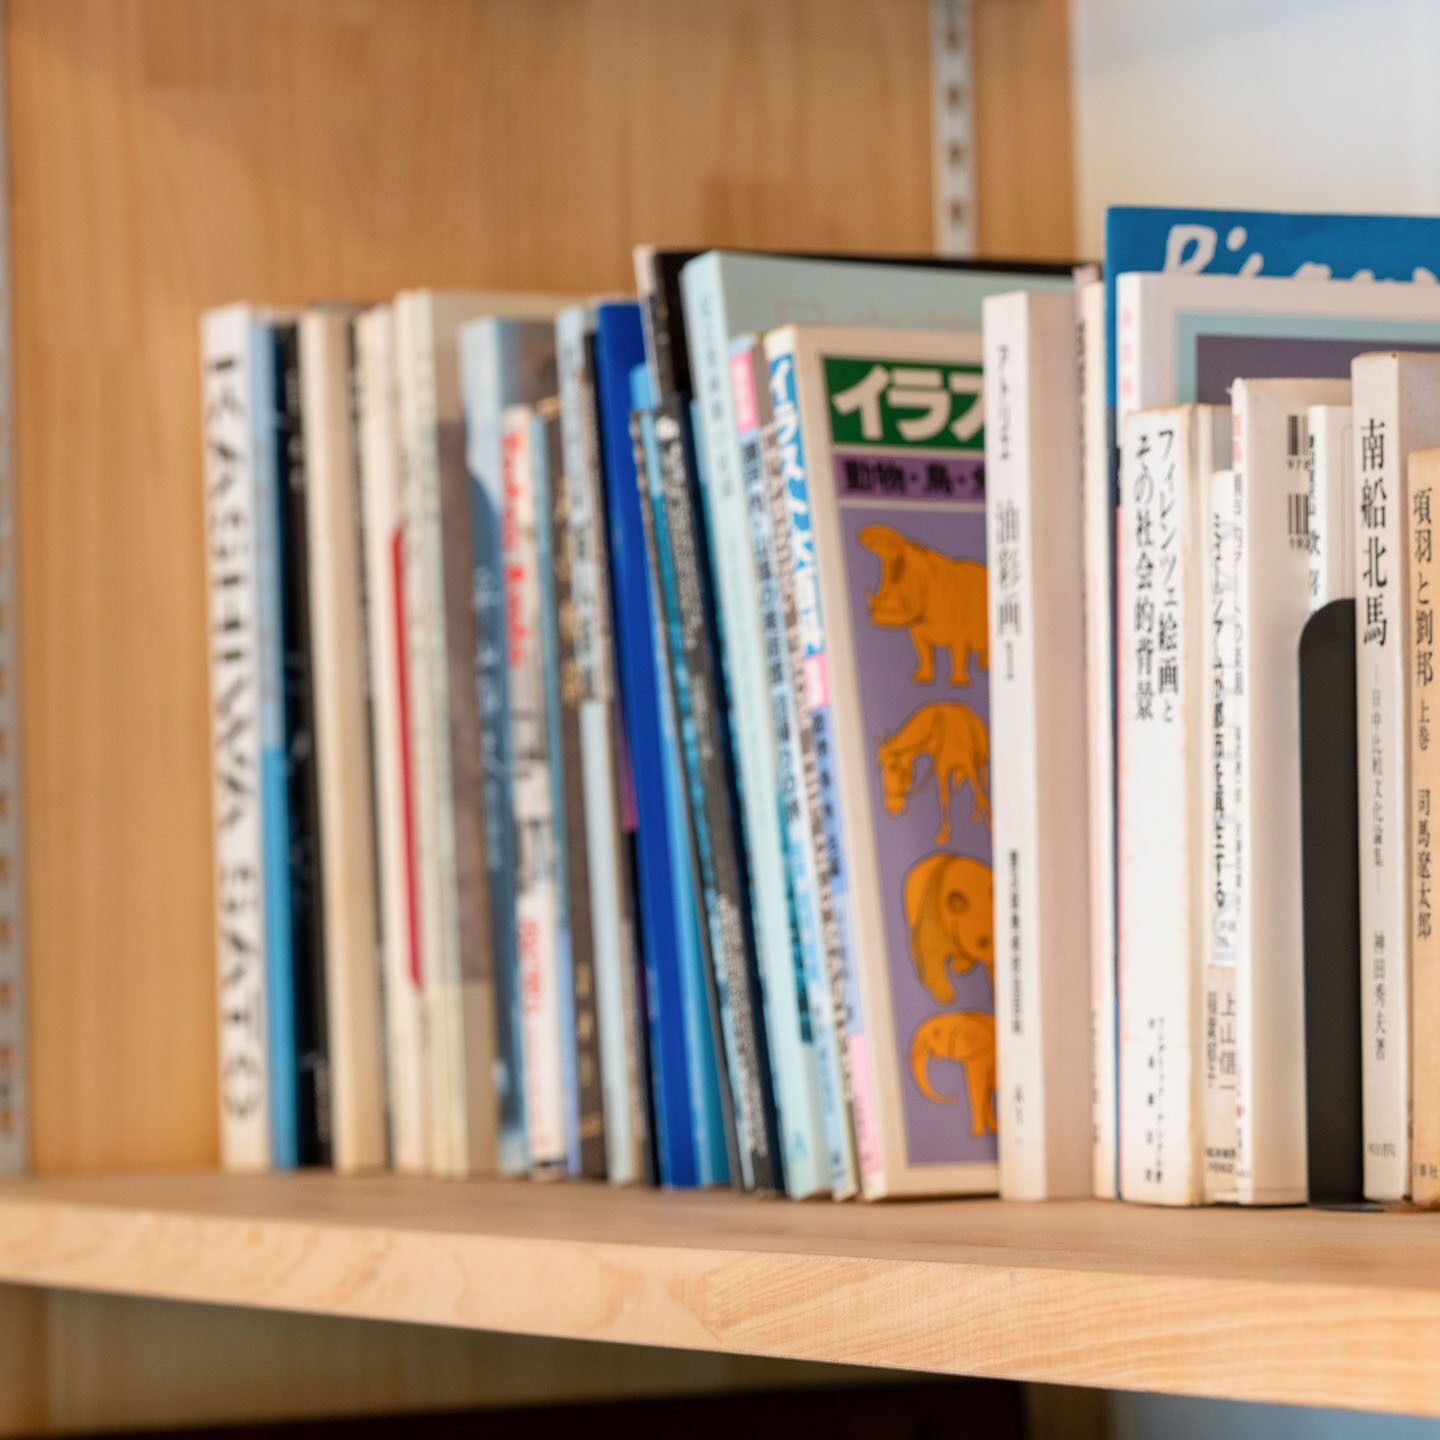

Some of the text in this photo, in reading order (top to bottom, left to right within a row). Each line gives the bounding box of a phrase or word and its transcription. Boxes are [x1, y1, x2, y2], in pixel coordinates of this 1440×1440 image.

[1133, 435, 1155, 722] その社会的背景
[1157, 429, 1179, 723] フィレンツェ絵画と
[1360, 418, 1388, 647] 南船北馬
[1412, 486, 1435, 752] 項羽と劉邦 上巻
[1415, 787, 1433, 940] 司馬遼太郎
